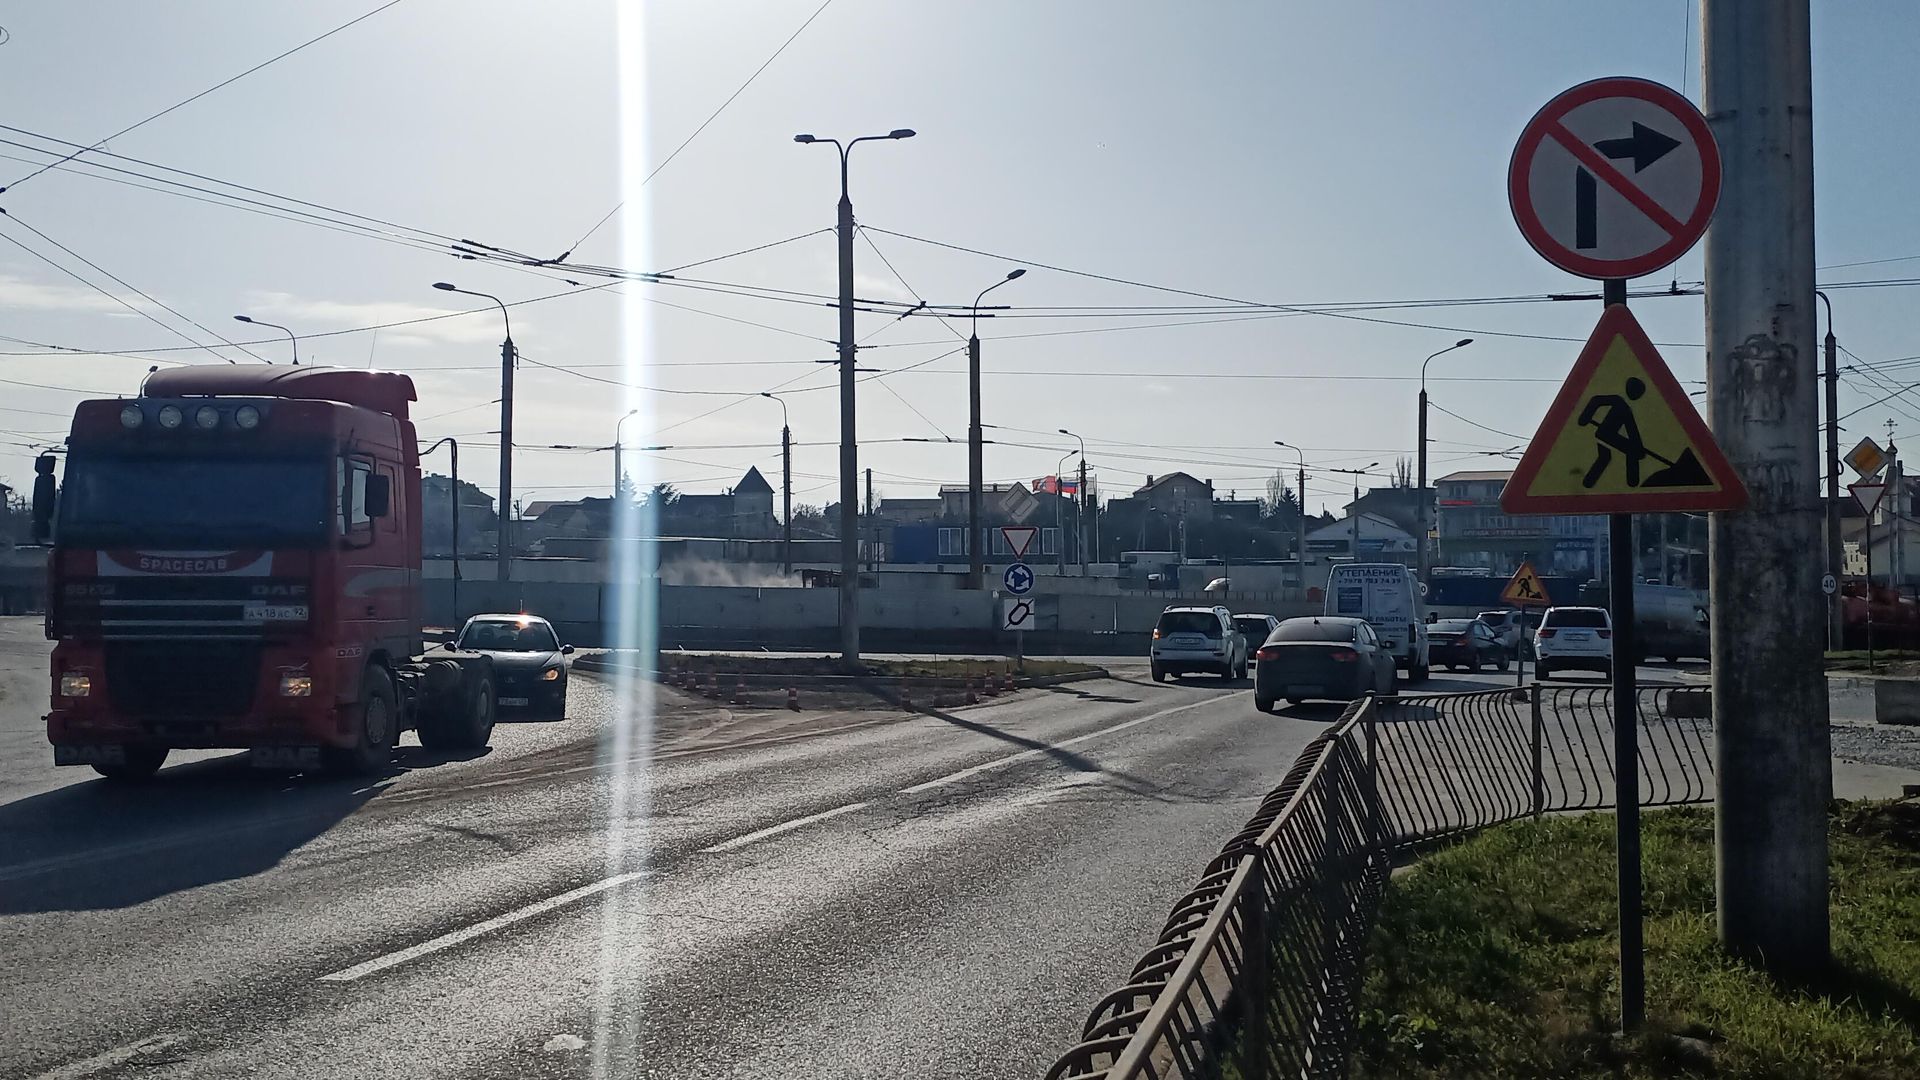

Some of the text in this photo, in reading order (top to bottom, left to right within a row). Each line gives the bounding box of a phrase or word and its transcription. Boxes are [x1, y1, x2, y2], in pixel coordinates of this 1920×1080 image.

[140, 557, 227, 571] SPACECAB
[1339, 569, 1400, 577] УТЕПЛЕНИЕ
[1823, 580, 1835, 588] 40
[251, 585, 306, 596] DAF
[337, 647, 360, 657] DAF
